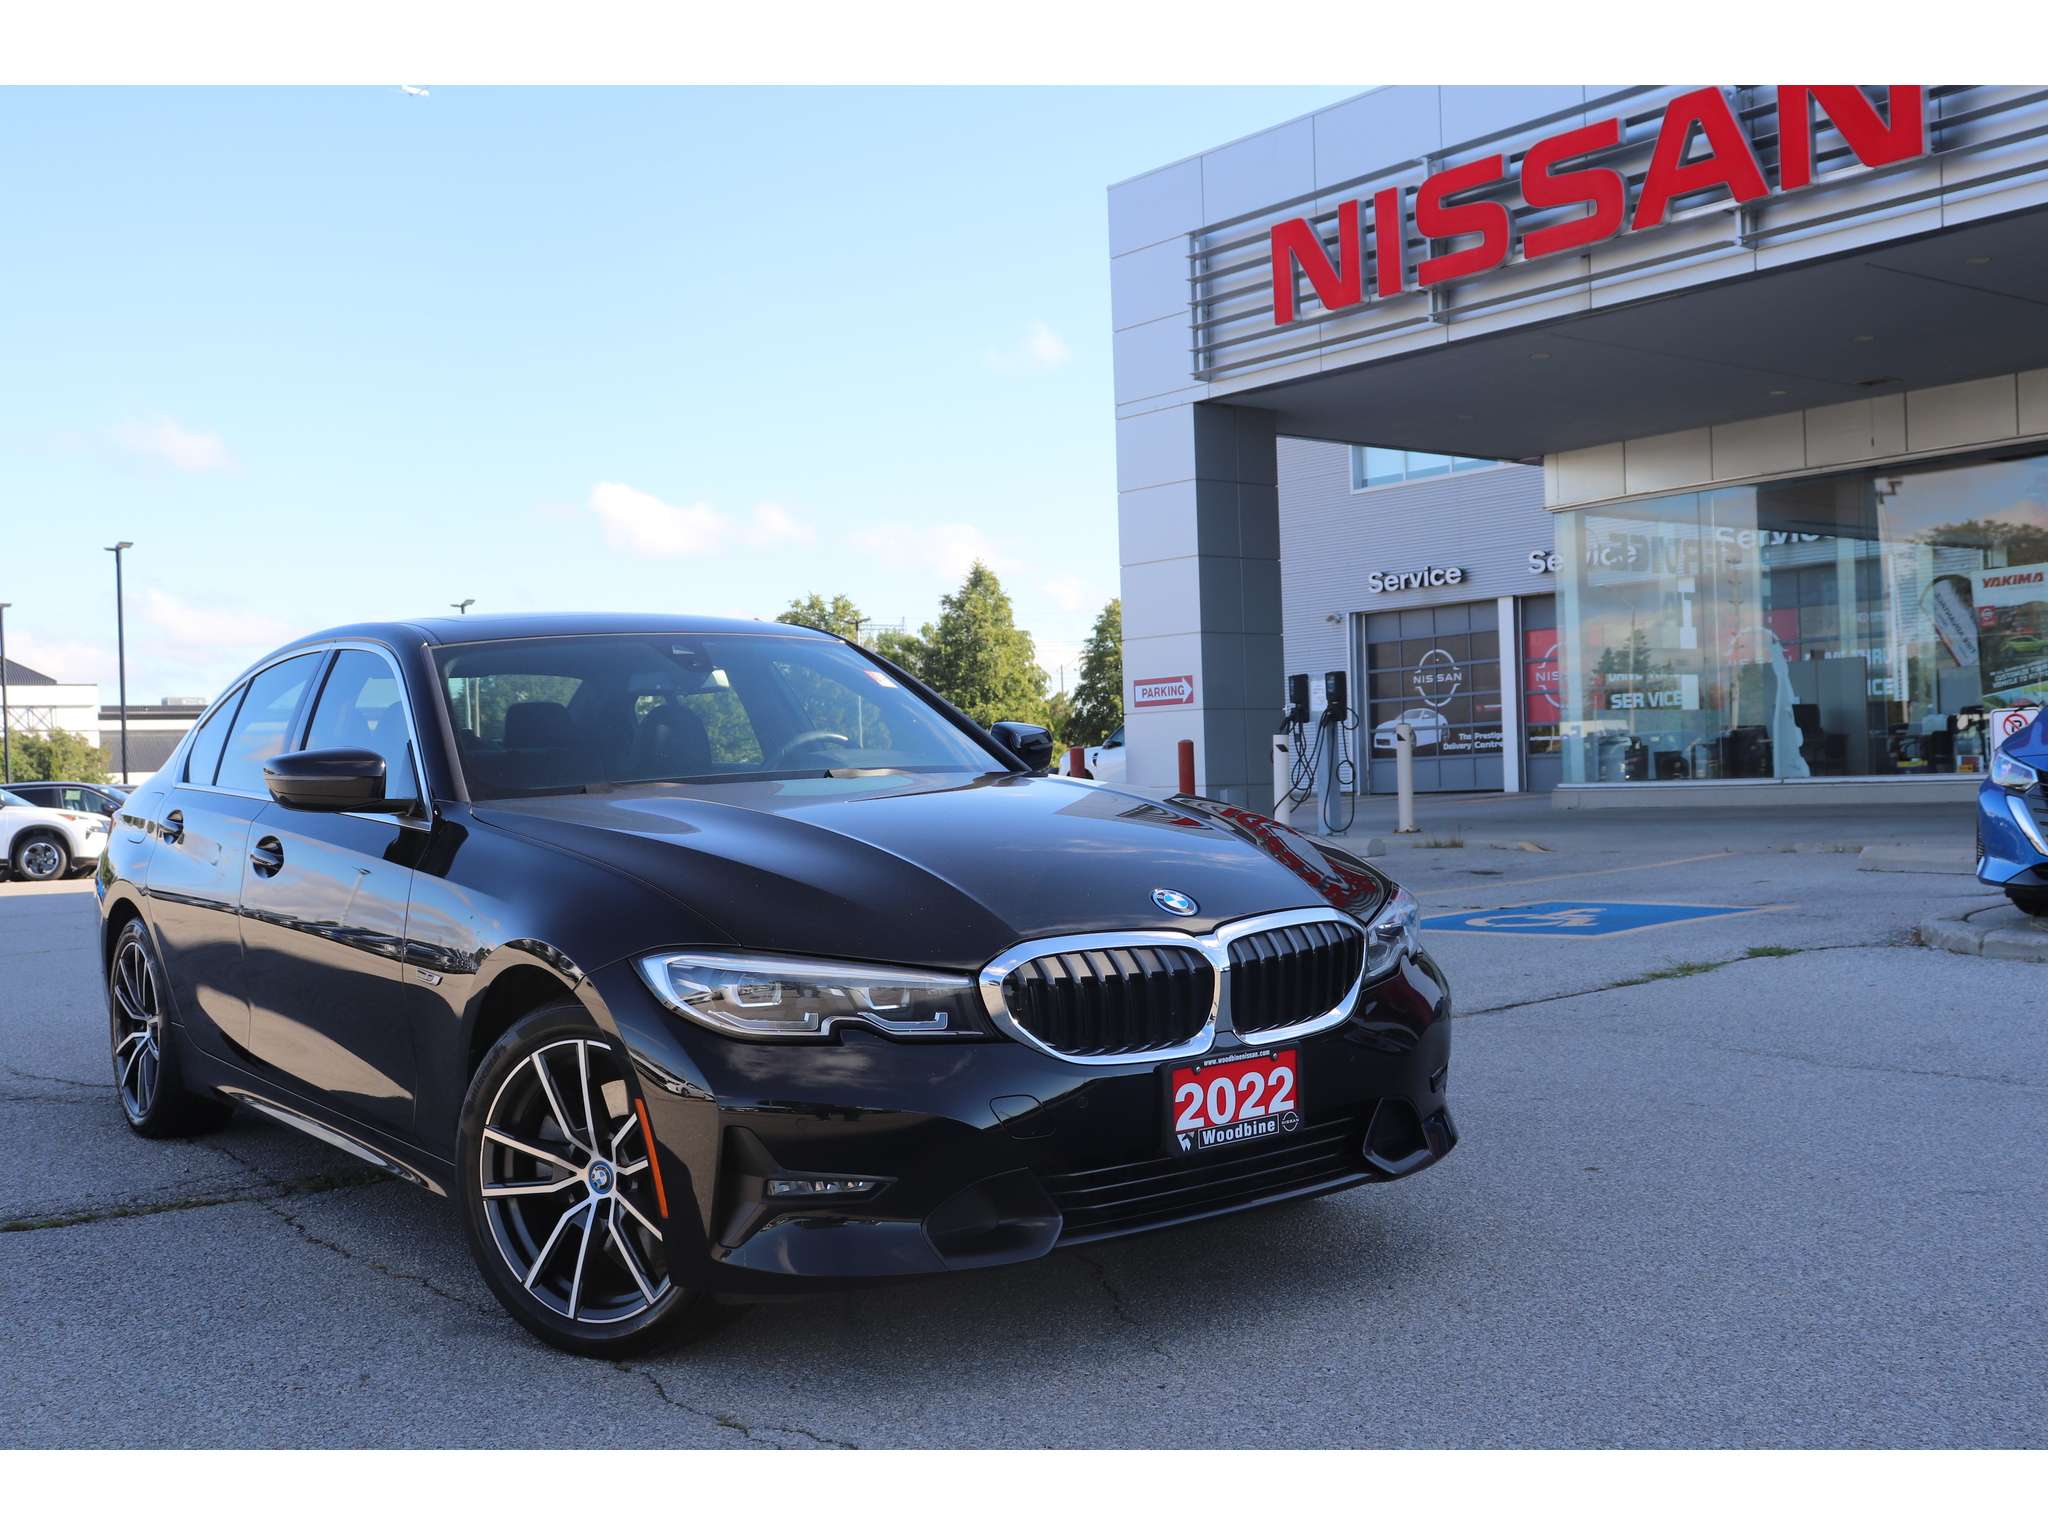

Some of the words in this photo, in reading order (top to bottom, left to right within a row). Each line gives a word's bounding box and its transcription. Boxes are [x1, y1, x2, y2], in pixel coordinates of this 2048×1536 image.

[1271, 85, 1930, 326] NISSAN
[1368, 566, 1463, 593] Service
[1983, 572, 2044, 588] YAKIMA
[1413, 672, 1462, 684] NISSAN
[1142, 685, 1185, 698] PARKING
[1459, 733, 1472, 741] The
[1443, 743, 1472, 751] Delivery
[1203, 1049, 1271, 1067] www.woodbinenissan.com
[1174, 1066, 1295, 1132] 2022
[1281, 1117, 1300, 1125] NISSAN
[1203, 1120, 1276, 1145] Woodbine
